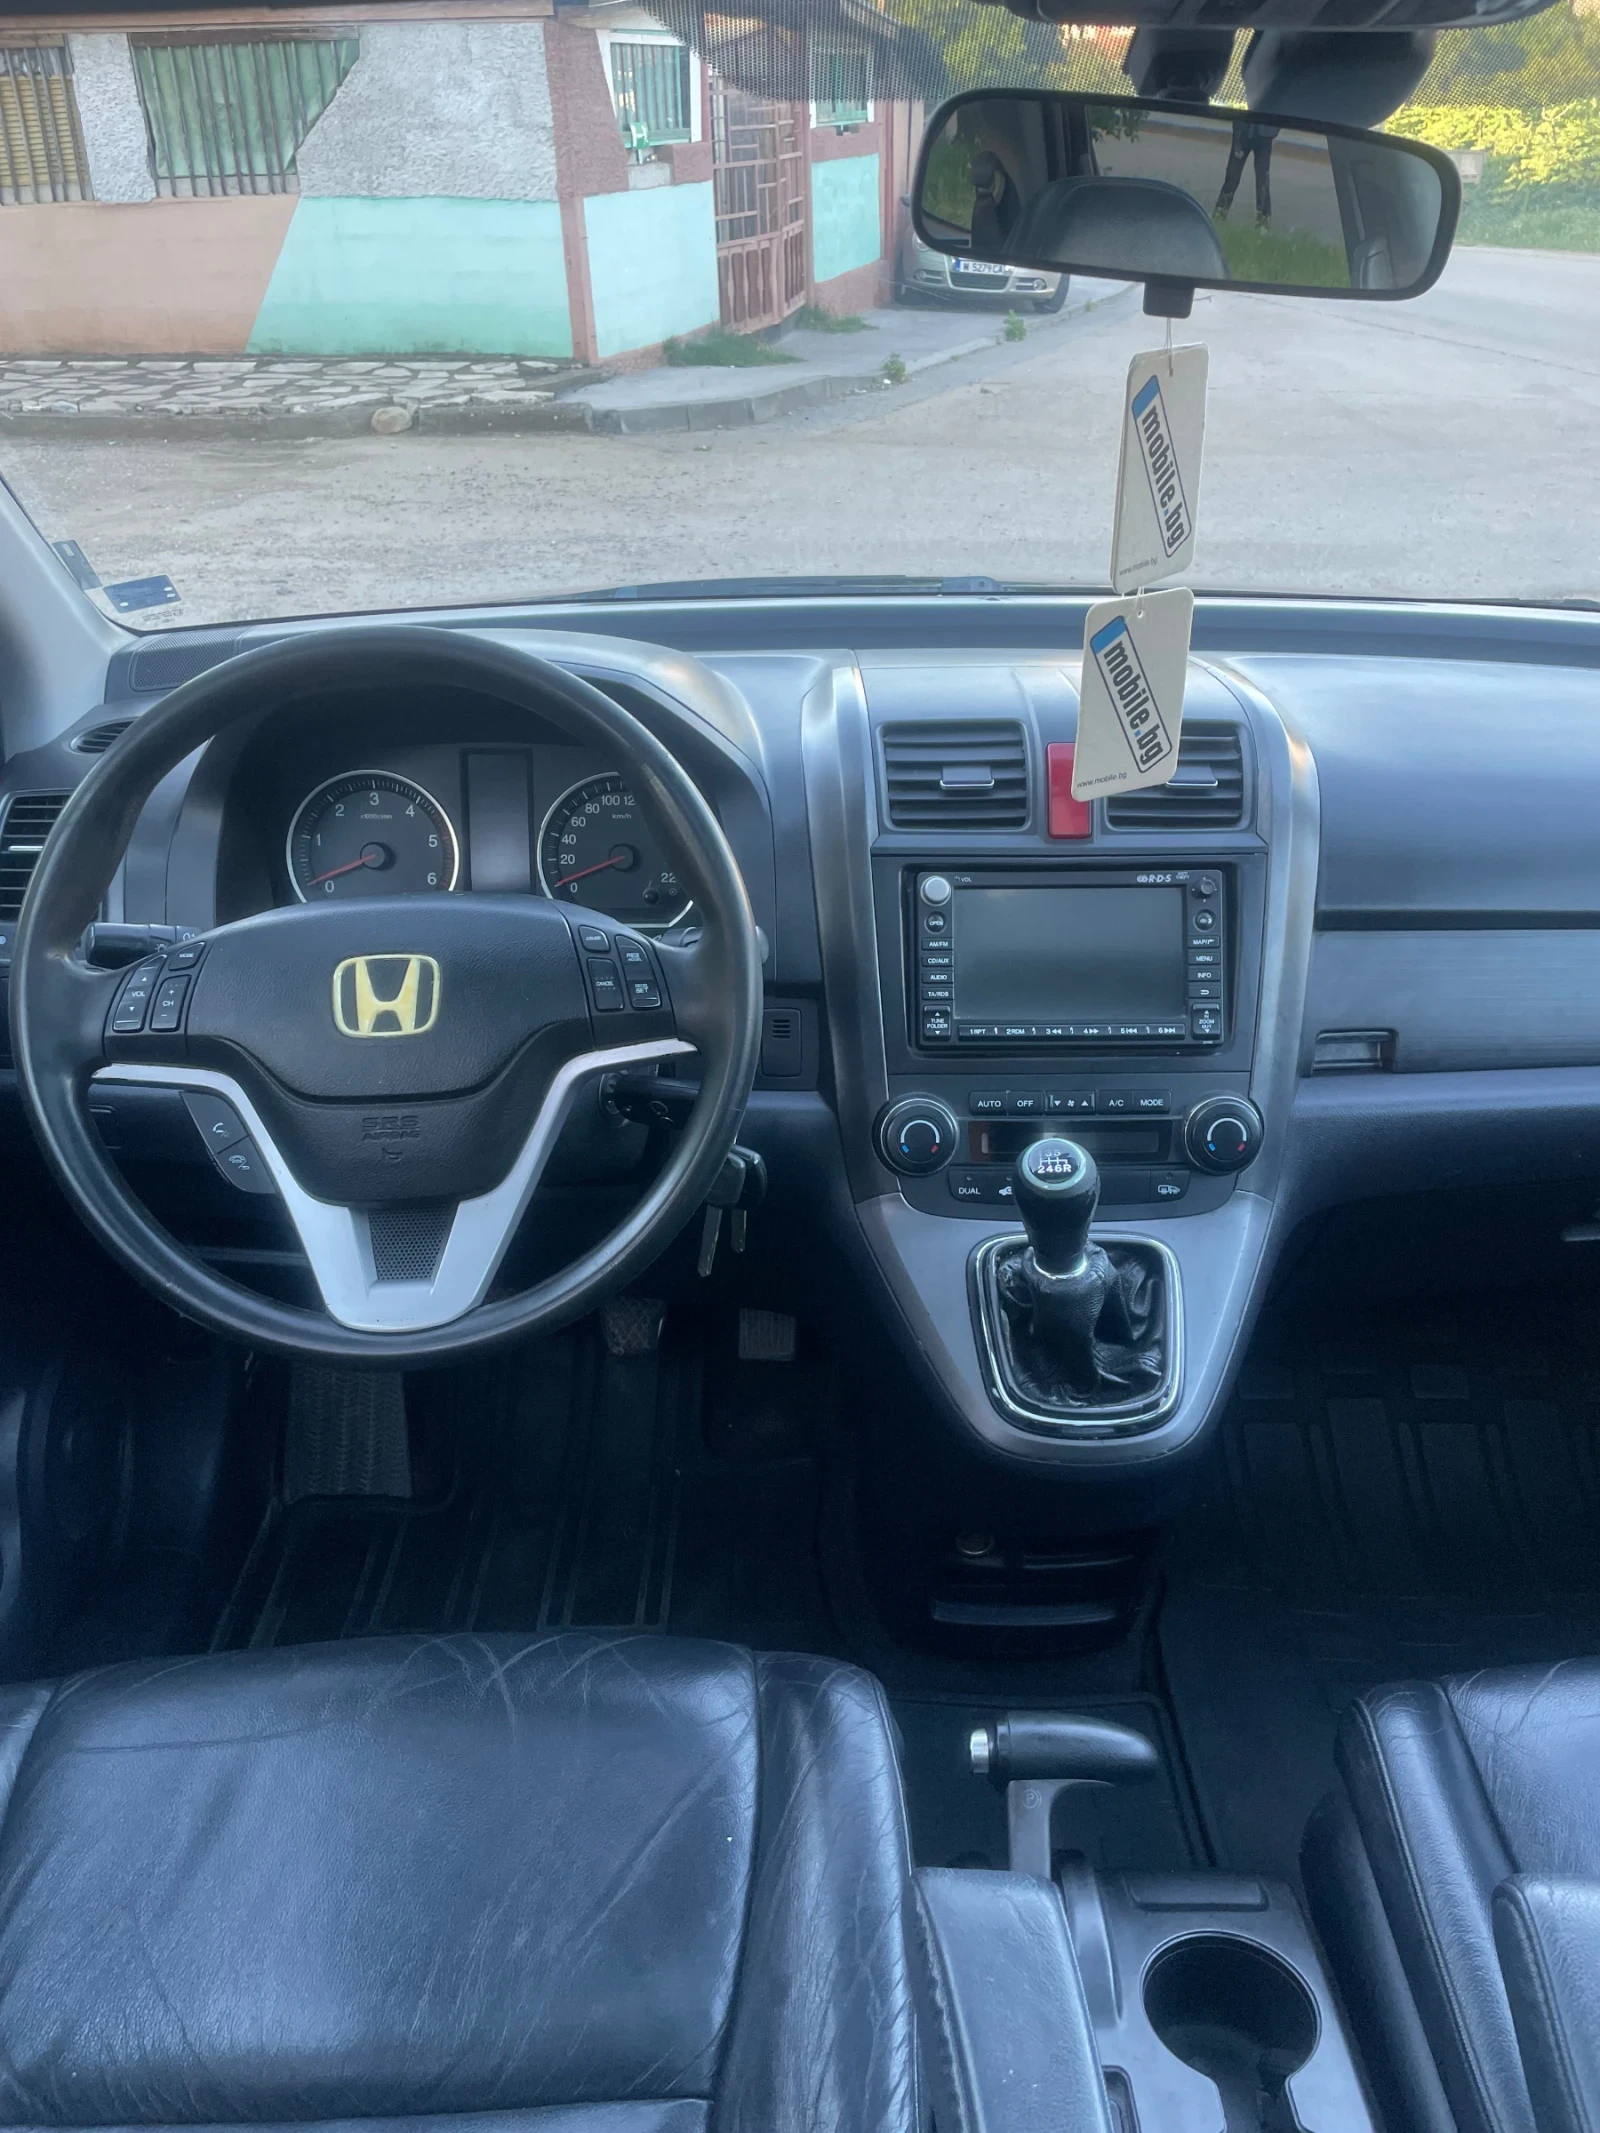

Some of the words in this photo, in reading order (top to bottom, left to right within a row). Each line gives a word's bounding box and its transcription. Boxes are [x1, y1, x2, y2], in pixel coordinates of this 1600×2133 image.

[1142, 405, 1184, 548] mobile.bg
[1103, 641, 1163, 766] mobile.bg
[370, 792, 379, 805] 3
[601, 795, 620, 806] 100
[623, 796, 635, 806] 12
[335, 804, 344, 816] 2
[405, 804, 415, 817] 4
[585, 803, 599, 814] 80
[571, 817, 586, 827] 60
[316, 833, 321, 846] 1
[428, 834, 438, 847] 5
[561, 834, 576, 844] 40
[560, 854, 575, 864] 20
[427, 872, 436, 884] 6
[325, 880, 334, 892] 0
[570, 883, 578, 893] 0
[977, 1100, 1001, 1108] AUTO
[1108, 1099, 1124, 1107] A/C
[958, 1186, 981, 1195] DUAL
